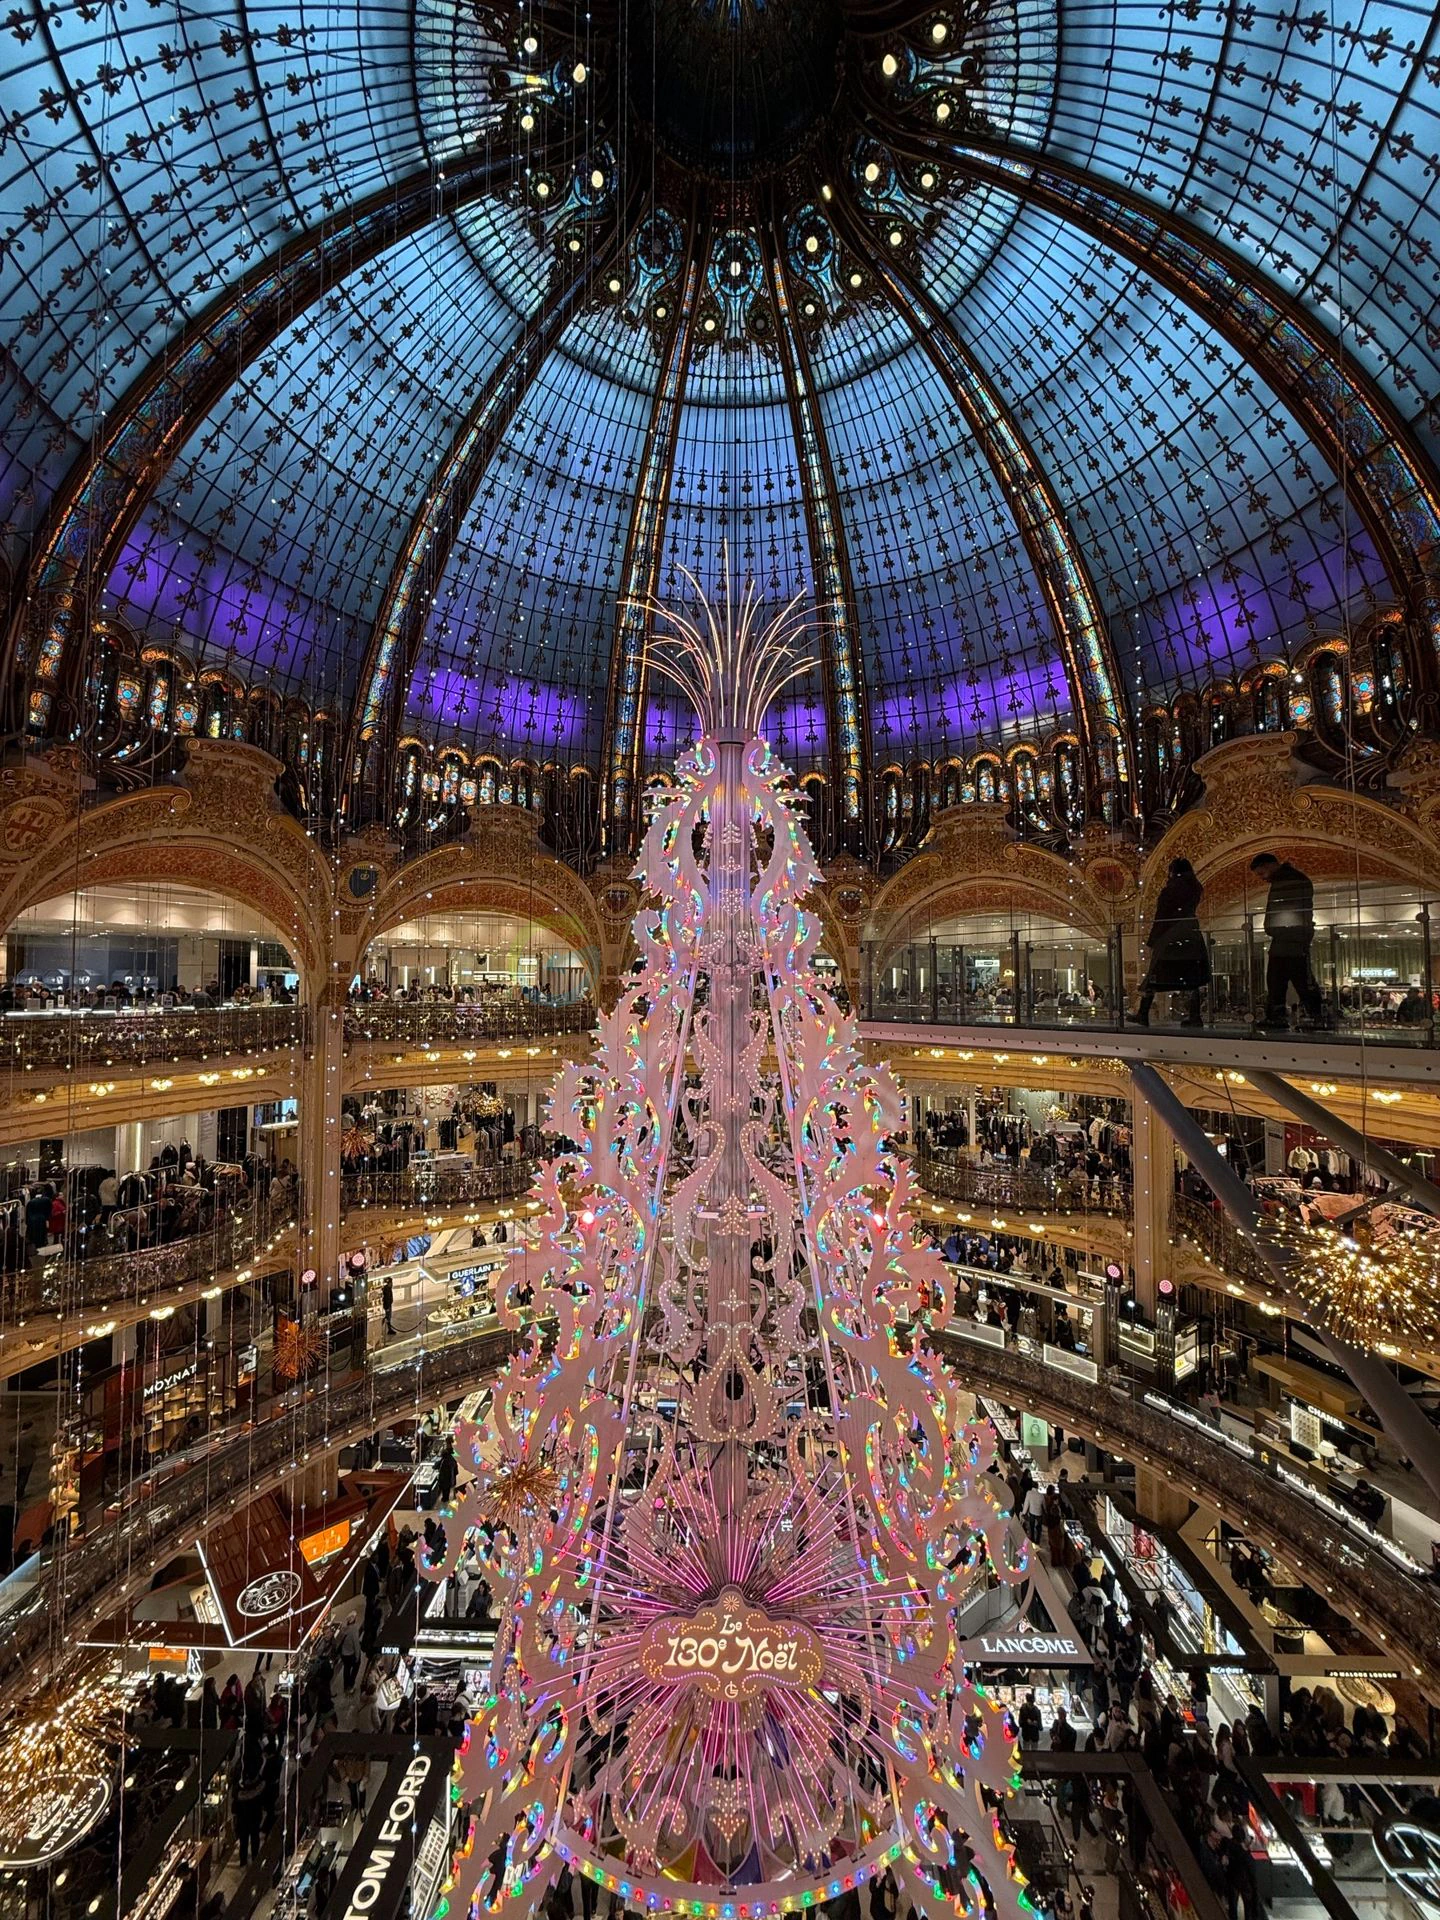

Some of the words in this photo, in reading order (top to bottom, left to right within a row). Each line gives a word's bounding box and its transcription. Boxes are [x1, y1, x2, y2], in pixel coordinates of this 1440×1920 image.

[451, 1264, 491, 1279] GUERLAIN
[143, 1363, 198, 1398] MOYNAT
[1307, 1405, 1346, 1430] CHANEL
[719, 1614, 743, 1635] Le
[381, 1646, 400, 1655] DIOR
[721, 1636, 798, 1674] Noël
[980, 1636, 1079, 1655] LANCÔME
[342, 1849, 396, 1920] TOM
[377, 1755, 432, 1842] FORD
